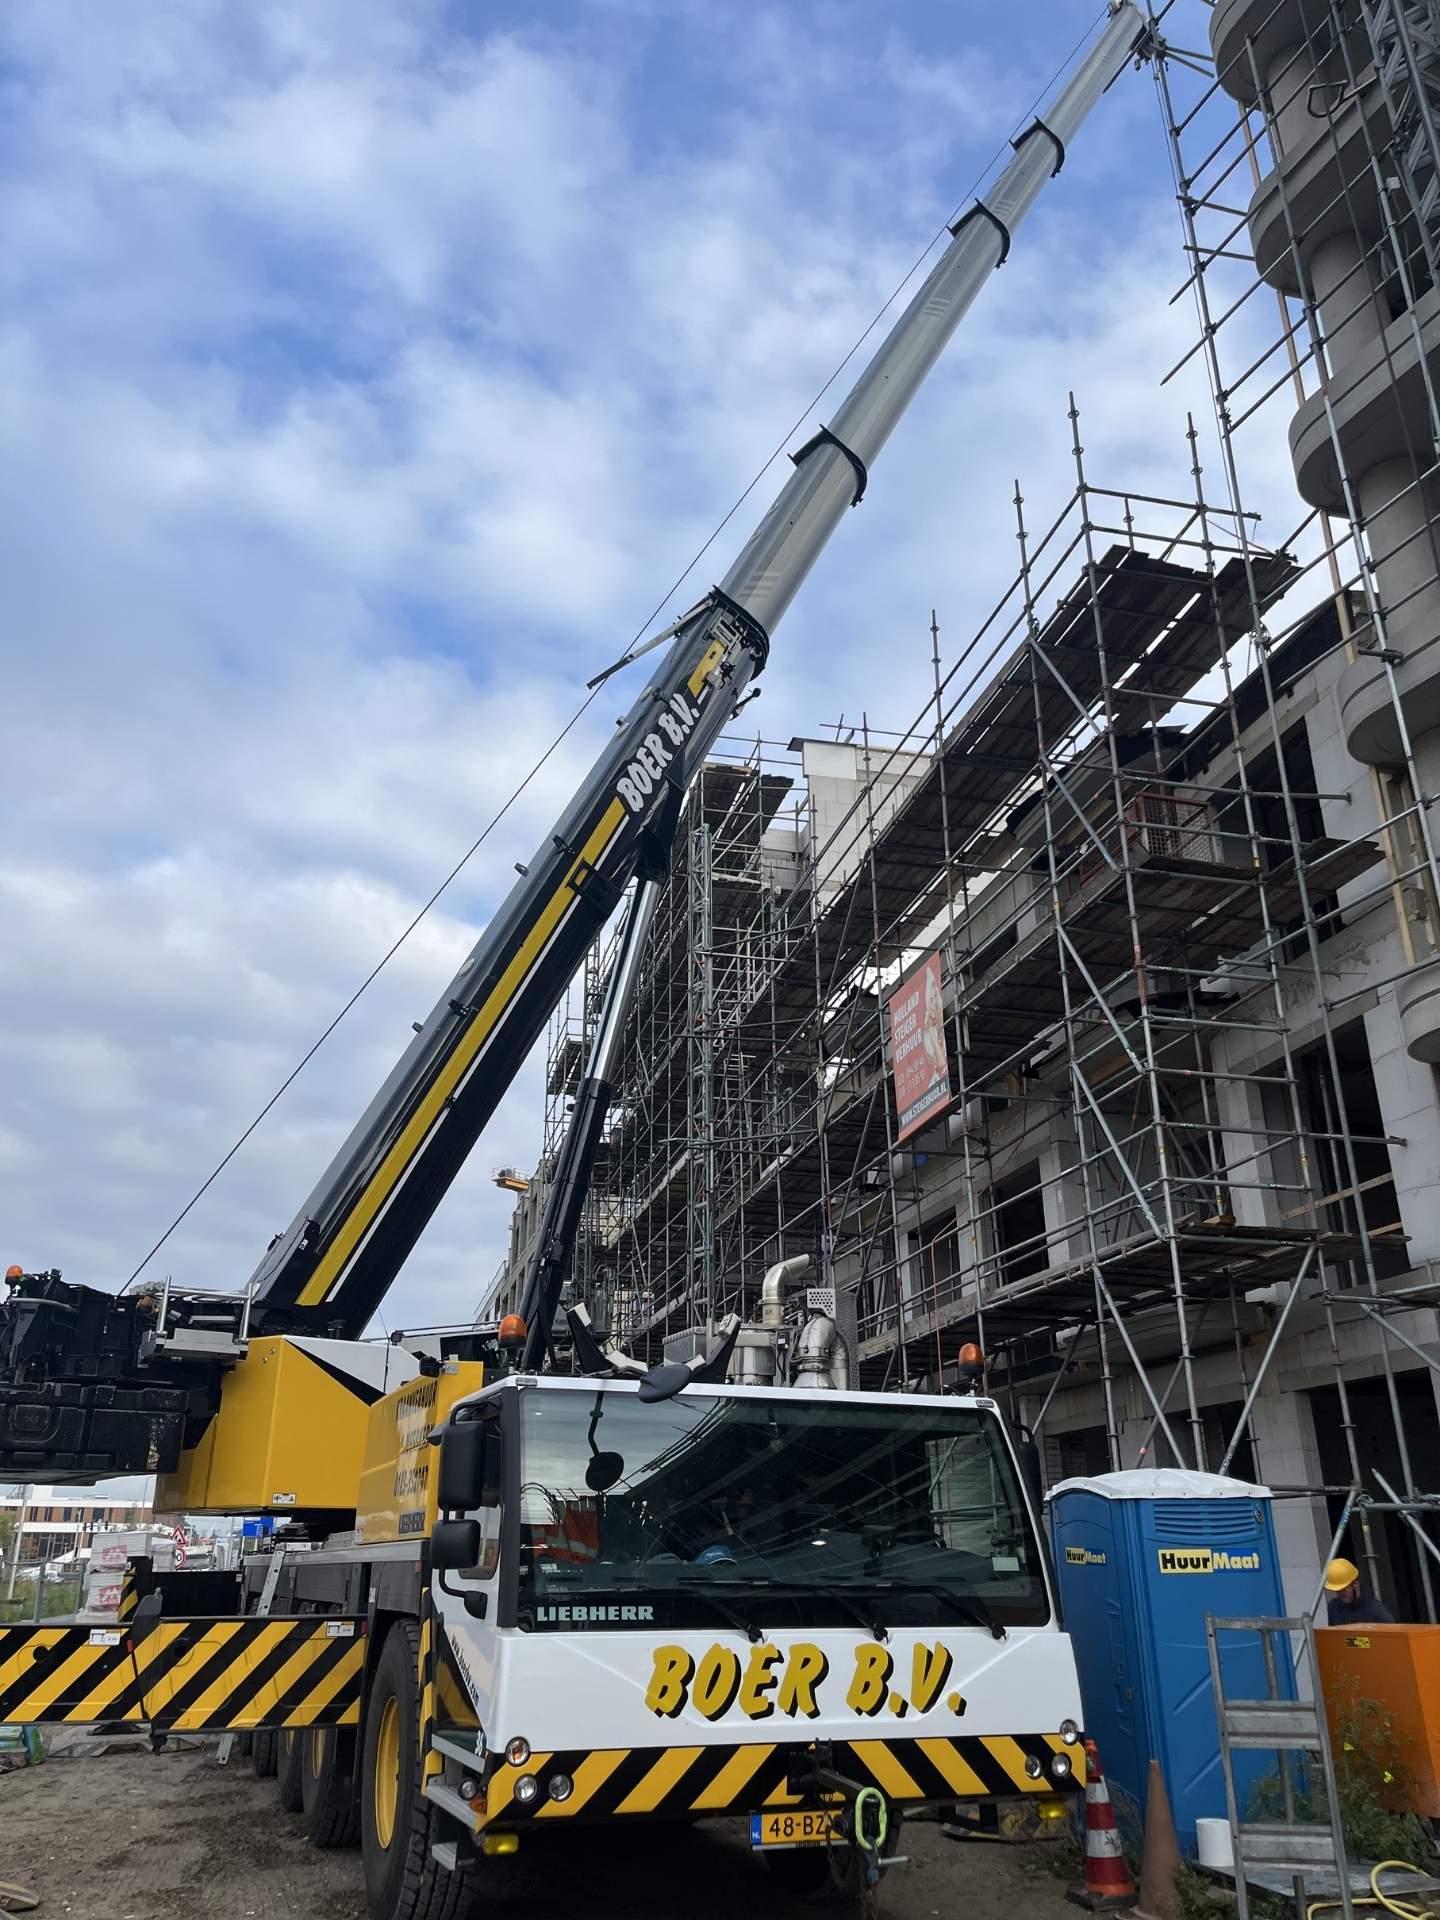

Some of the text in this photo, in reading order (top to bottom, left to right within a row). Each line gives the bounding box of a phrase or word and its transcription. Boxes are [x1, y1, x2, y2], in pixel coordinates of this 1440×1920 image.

[617, 693, 700, 812] BOER B.V.
[894, 991, 920, 1027] HOLLAND
[894, 1013, 917, 1046] STEIGER
[895, 1028, 923, 1065] VERHUUR
[1066, 1548, 1106, 1564] HuurMaat
[1161, 1552, 1260, 1570] HuurMaat
[536, 1606, 655, 1622] LIEBHERR
[645, 1641, 968, 1722] BOER B.V.
